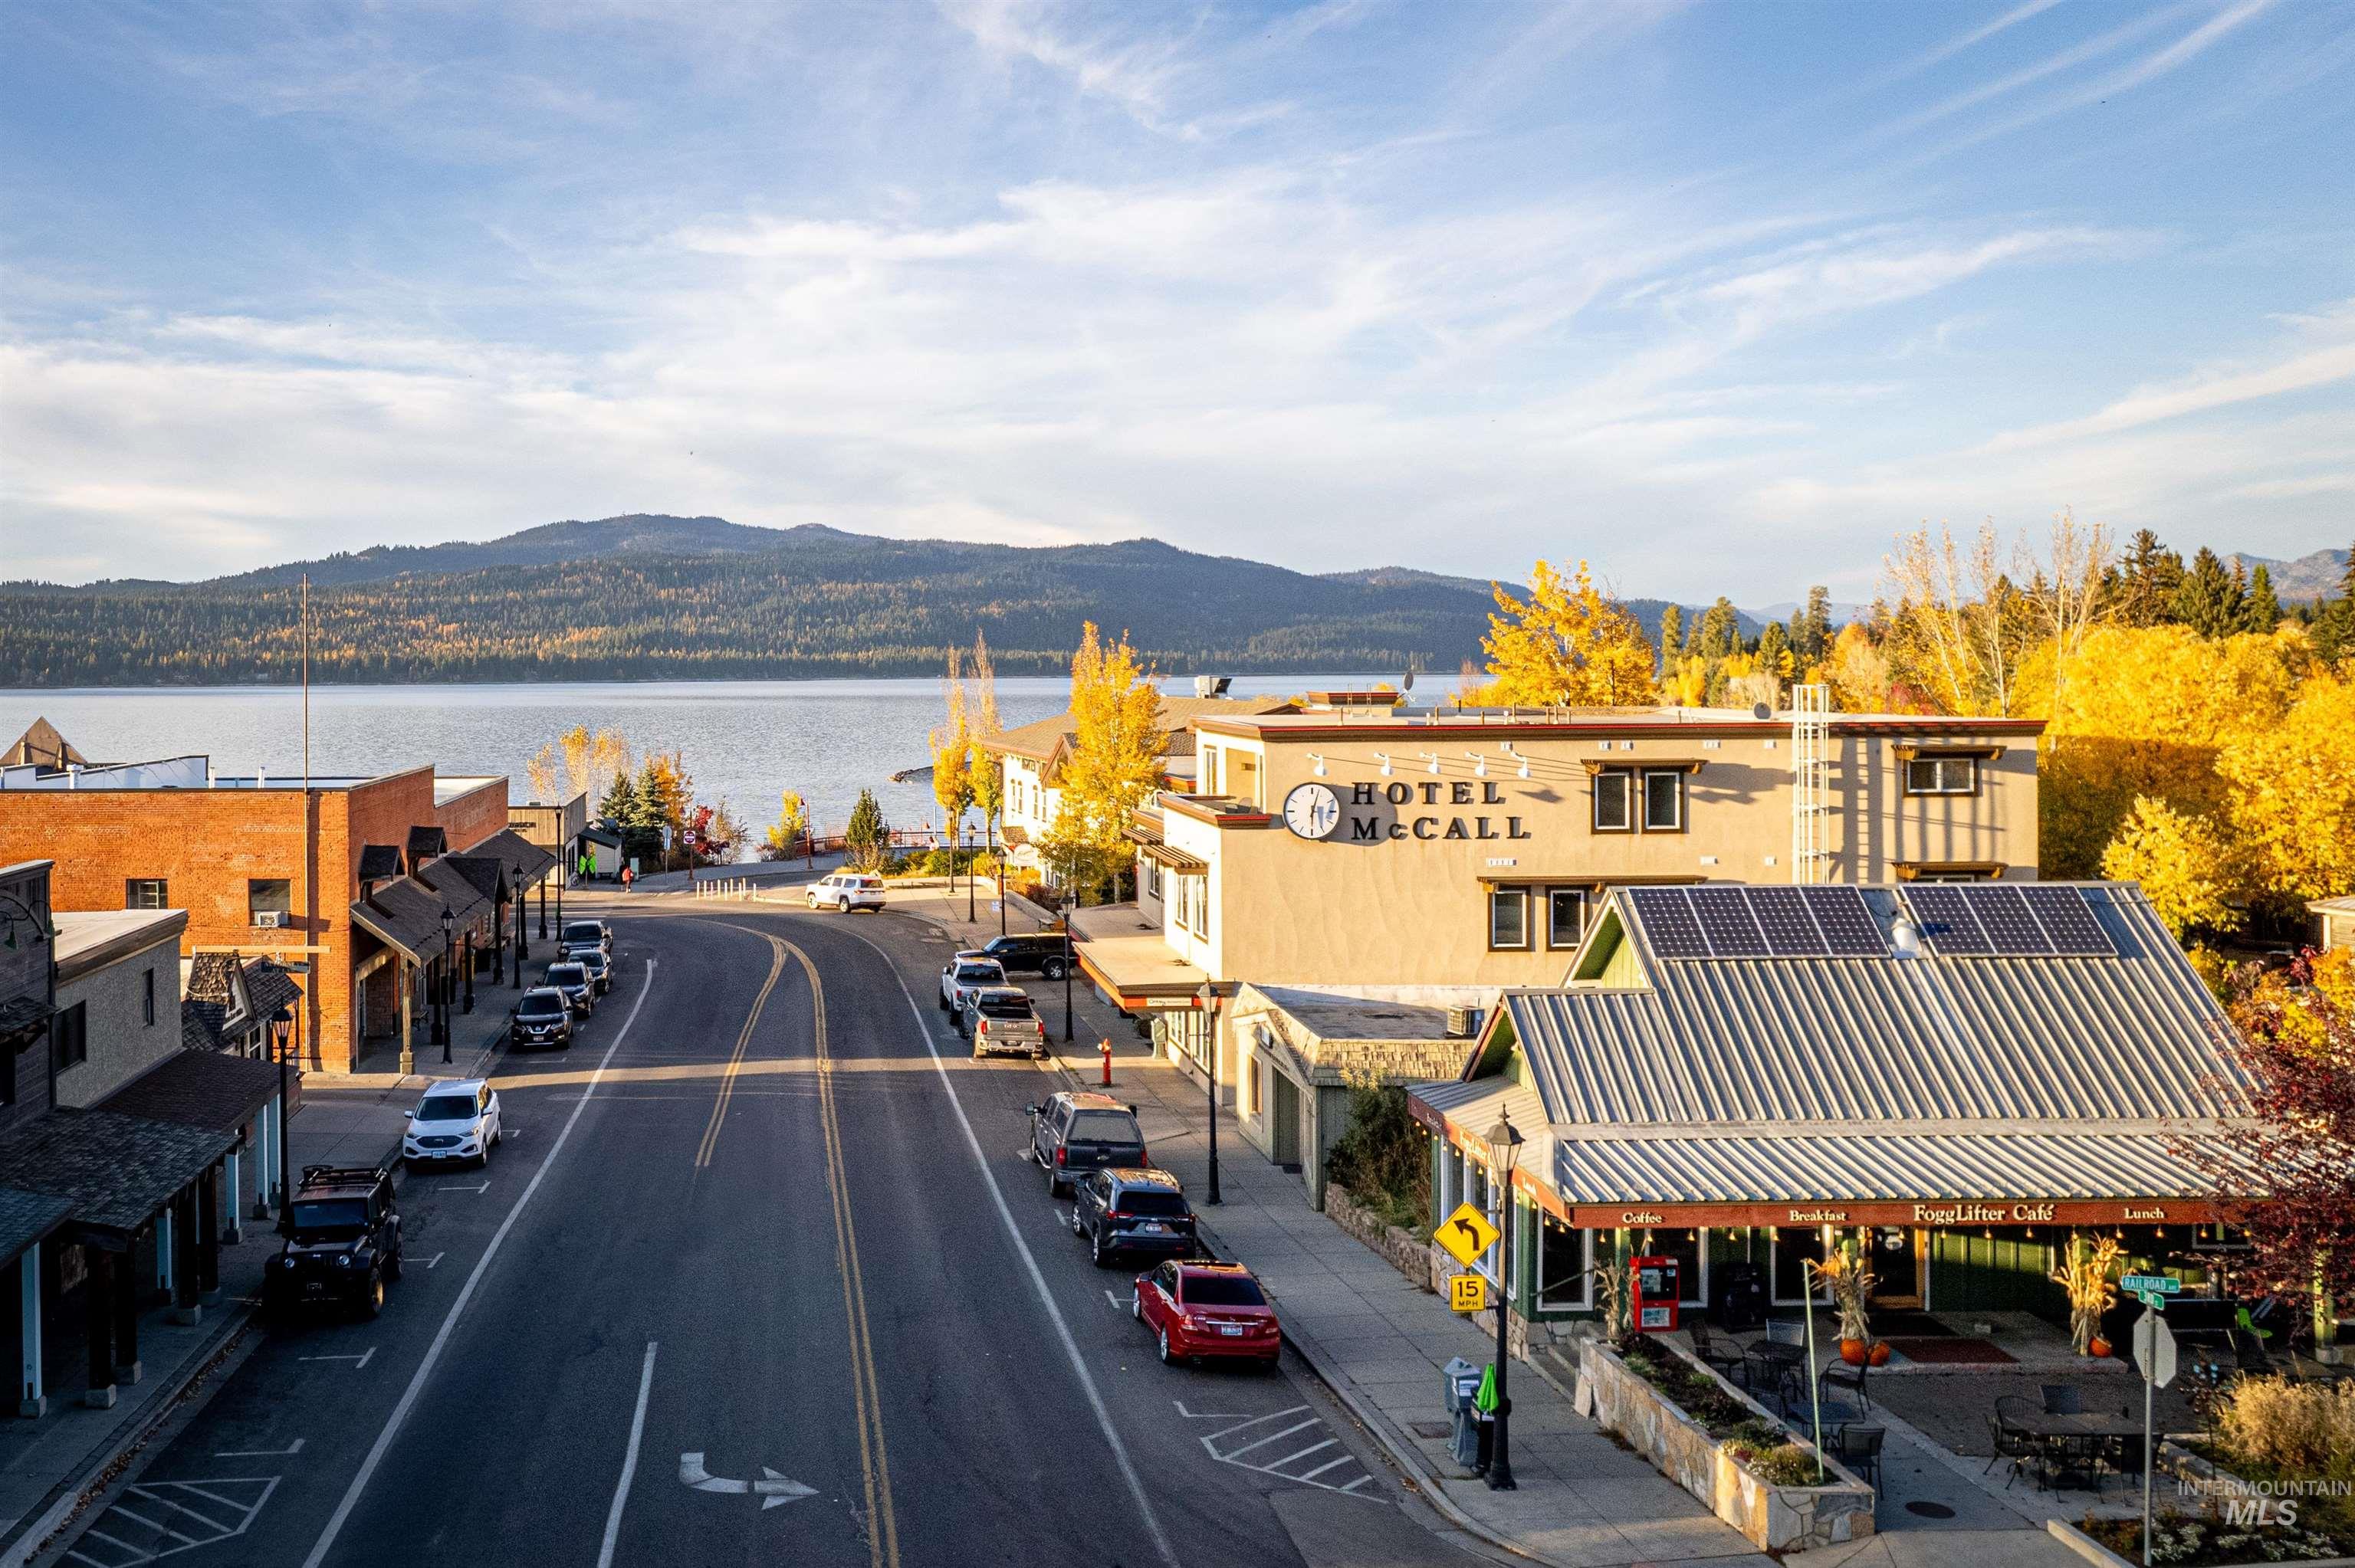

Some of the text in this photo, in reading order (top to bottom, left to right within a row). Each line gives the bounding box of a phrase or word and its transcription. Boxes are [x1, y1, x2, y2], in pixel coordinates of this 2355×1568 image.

[1351, 782, 1506, 805] HOTEL
[1351, 816, 1531, 840] McCALL
[1622, 1212, 1662, 1224] Coffee
[1789, 1209, 1846, 1222] Breakfast
[1913, 1203, 2054, 1225] FoggLifter Café
[2124, 1207, 2164, 1219] Lunch
[1458, 1281, 1479, 1297] 15
[2124, 1278, 2166, 1291] RAILROAD
